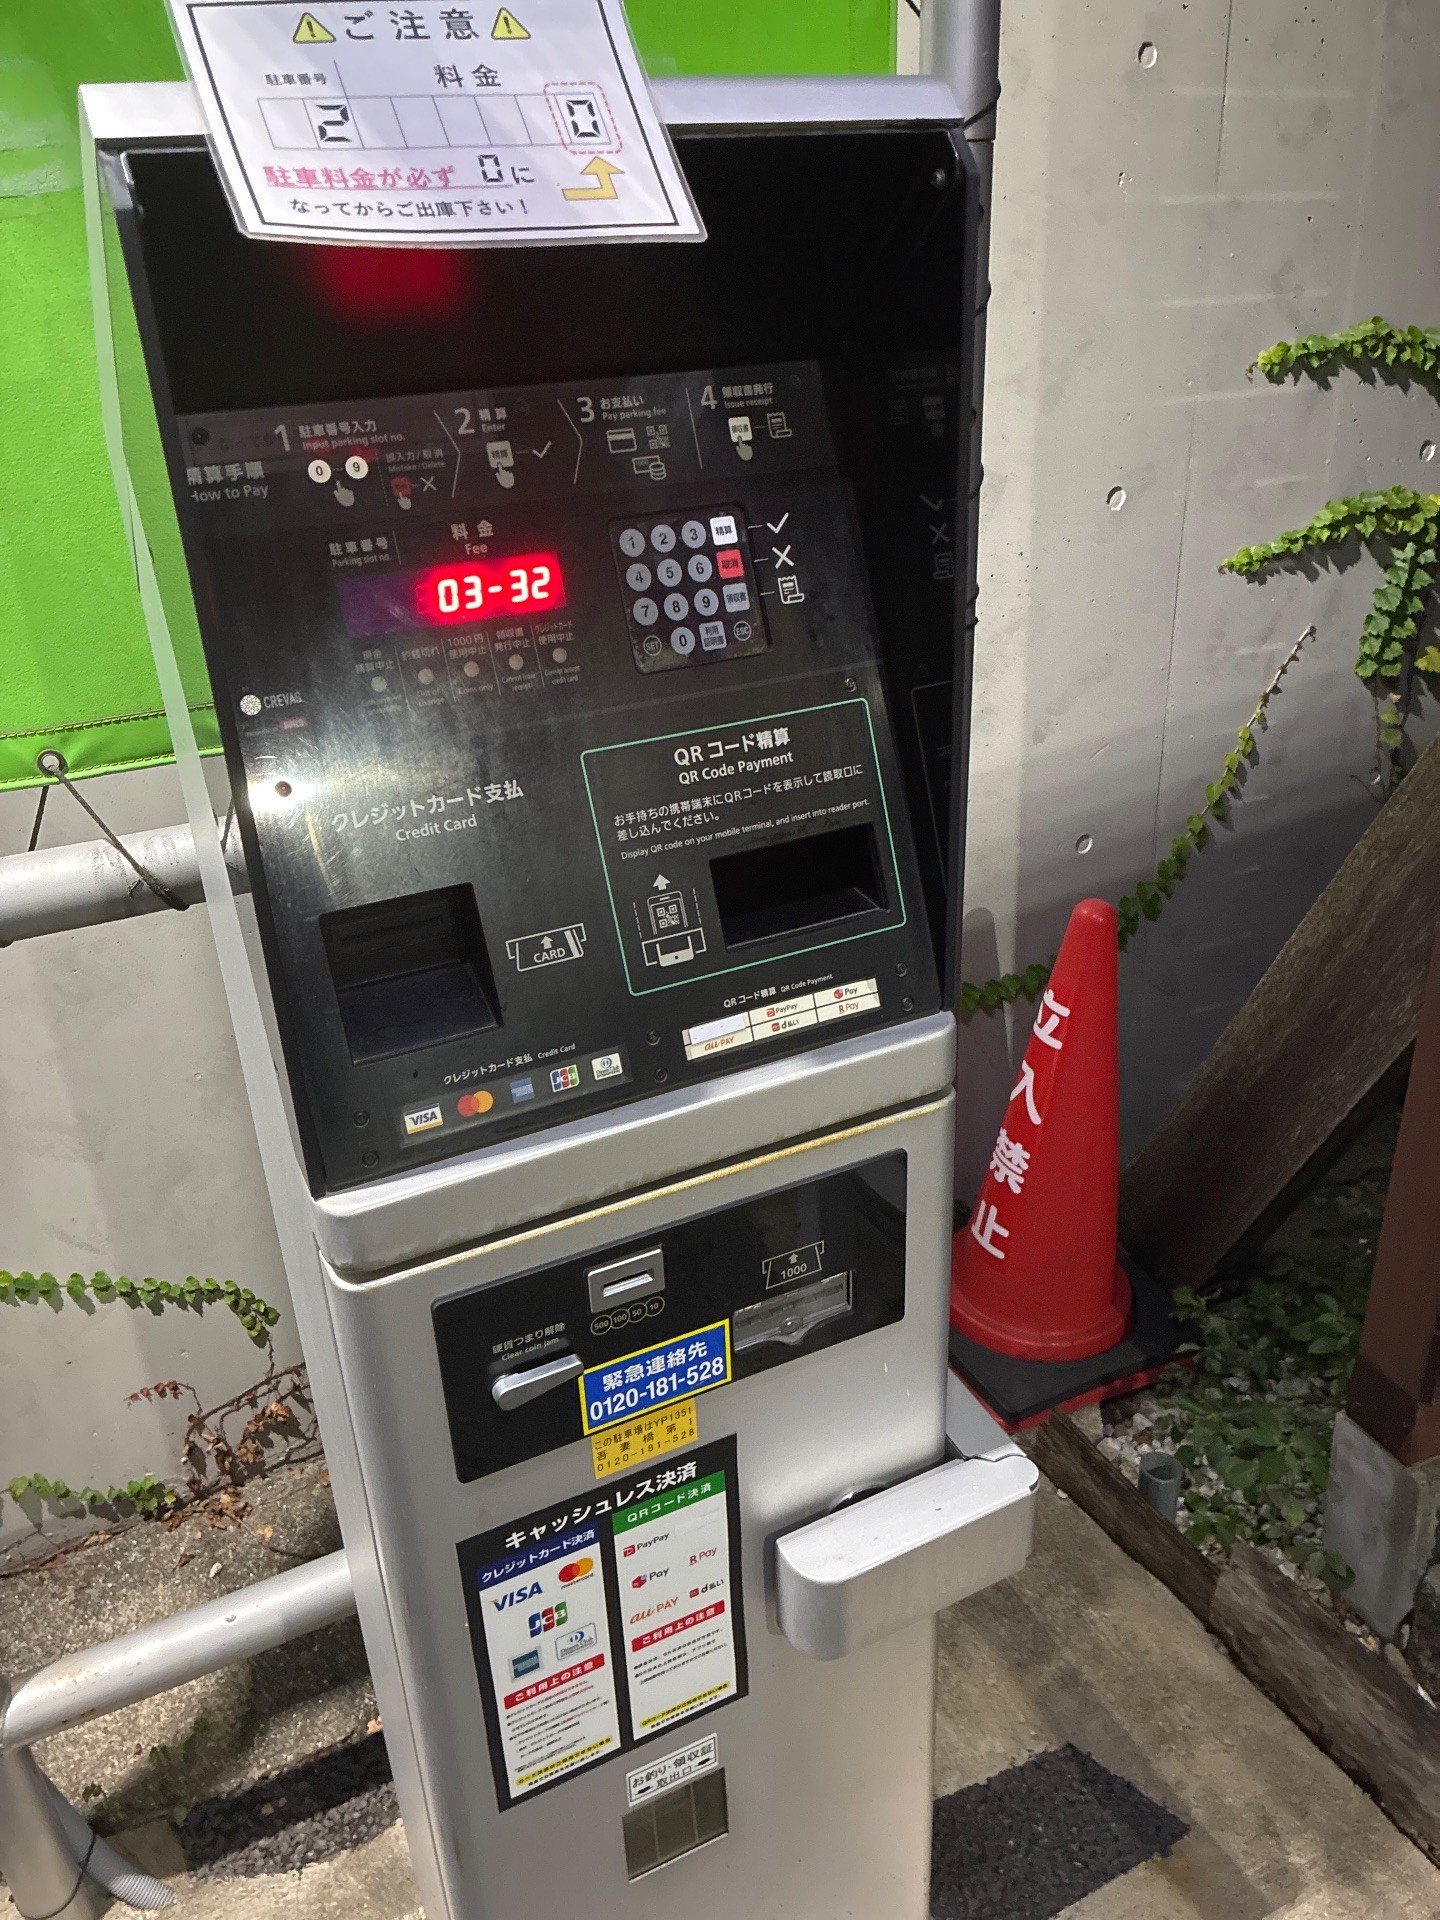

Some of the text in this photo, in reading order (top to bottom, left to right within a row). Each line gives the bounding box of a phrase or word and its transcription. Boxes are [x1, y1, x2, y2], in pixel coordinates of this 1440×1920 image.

[344, 8, 480, 42] ご注意
[264, 71, 327, 87] 駐車番号
[433, 63, 502, 89] 料金
[317, 104, 351, 142] 2
[577, 396, 595, 423] 3
[601, 395, 645, 410] お支払い
[700, 385, 717, 410] 4
[454, 407, 476, 435] 2
[620, 408, 650, 420] parking
[274, 423, 291, 452] 1
[302, 440, 330, 450] Input
[331, 436, 368, 449] parking
[369, 434, 386, 444] slot
[225, 486, 240, 500] to
[243, 483, 269, 500] Pay
[450, 520, 494, 541] 料金
[465, 543, 488, 555] Fee
[437, 566, 551, 613] 03-32
[735, 626, 750, 636] ESC
[679, 751, 794, 785] QR Code Payment
[332, 780, 524, 832] クレジットカード支払
[395, 814, 478, 842] Credit Card
[621, 846, 649, 860] Display
[650, 843, 663, 854] QR
[665, 839, 682, 852] code
[685, 836, 695, 846] on
[696, 833, 713, 846] your
[715, 825, 741, 840] mobile
[741, 818, 774, 834] terminal,
[775, 814, 790, 826] and
[791, 810, 811, 822] insert
[812, 807, 827, 818] into
[828, 802, 851, 814] reader
[533, 947, 566, 964] CARD
[780, 973, 833, 994] QR Code Payment
[844, 986, 858, 997] Pay
[775, 1002, 798, 1014] PayPay
[537, 1043, 576, 1060] Credit Card
[443, 1053, 533, 1086] クレジットカード支払
[409, 1110, 438, 1126] VISA
[971, 989, 1070, 1260] 立入禁止
[780, 1263, 807, 1280] 1000
[594, 1301, 659, 1331] 500 100 50 10
[491, 1321, 566, 1354] 硬貨つまり解除
[501, 1337, 559, 1361] Clear coin jam
[602, 1342, 708, 1391] 緊急連絡先
[590, 1358, 725, 1421] 0120-181-528
[595, 1407, 692, 1450] この駐車場はYP1351
[597, 1428, 695, 1472] 0120-181-528
[505, 1461, 697, 1549] キャッシュレス決済
[627, 1483, 712, 1523] QRコード決済
[637, 1532, 670, 1551] PayPay
[699, 1547, 717, 1562] Pay
[482, 1529, 595, 1583] クレジットカード決済
[649, 1568, 670, 1582] Pay
[490, 1582, 543, 1612] VISA
[657, 1597, 679, 1613] PAY
[642, 1606, 716, 1645] ご利用上の注意
[515, 1660, 594, 1702] ご利用上の注意
[657, 1768, 692, 1788] 取出口
